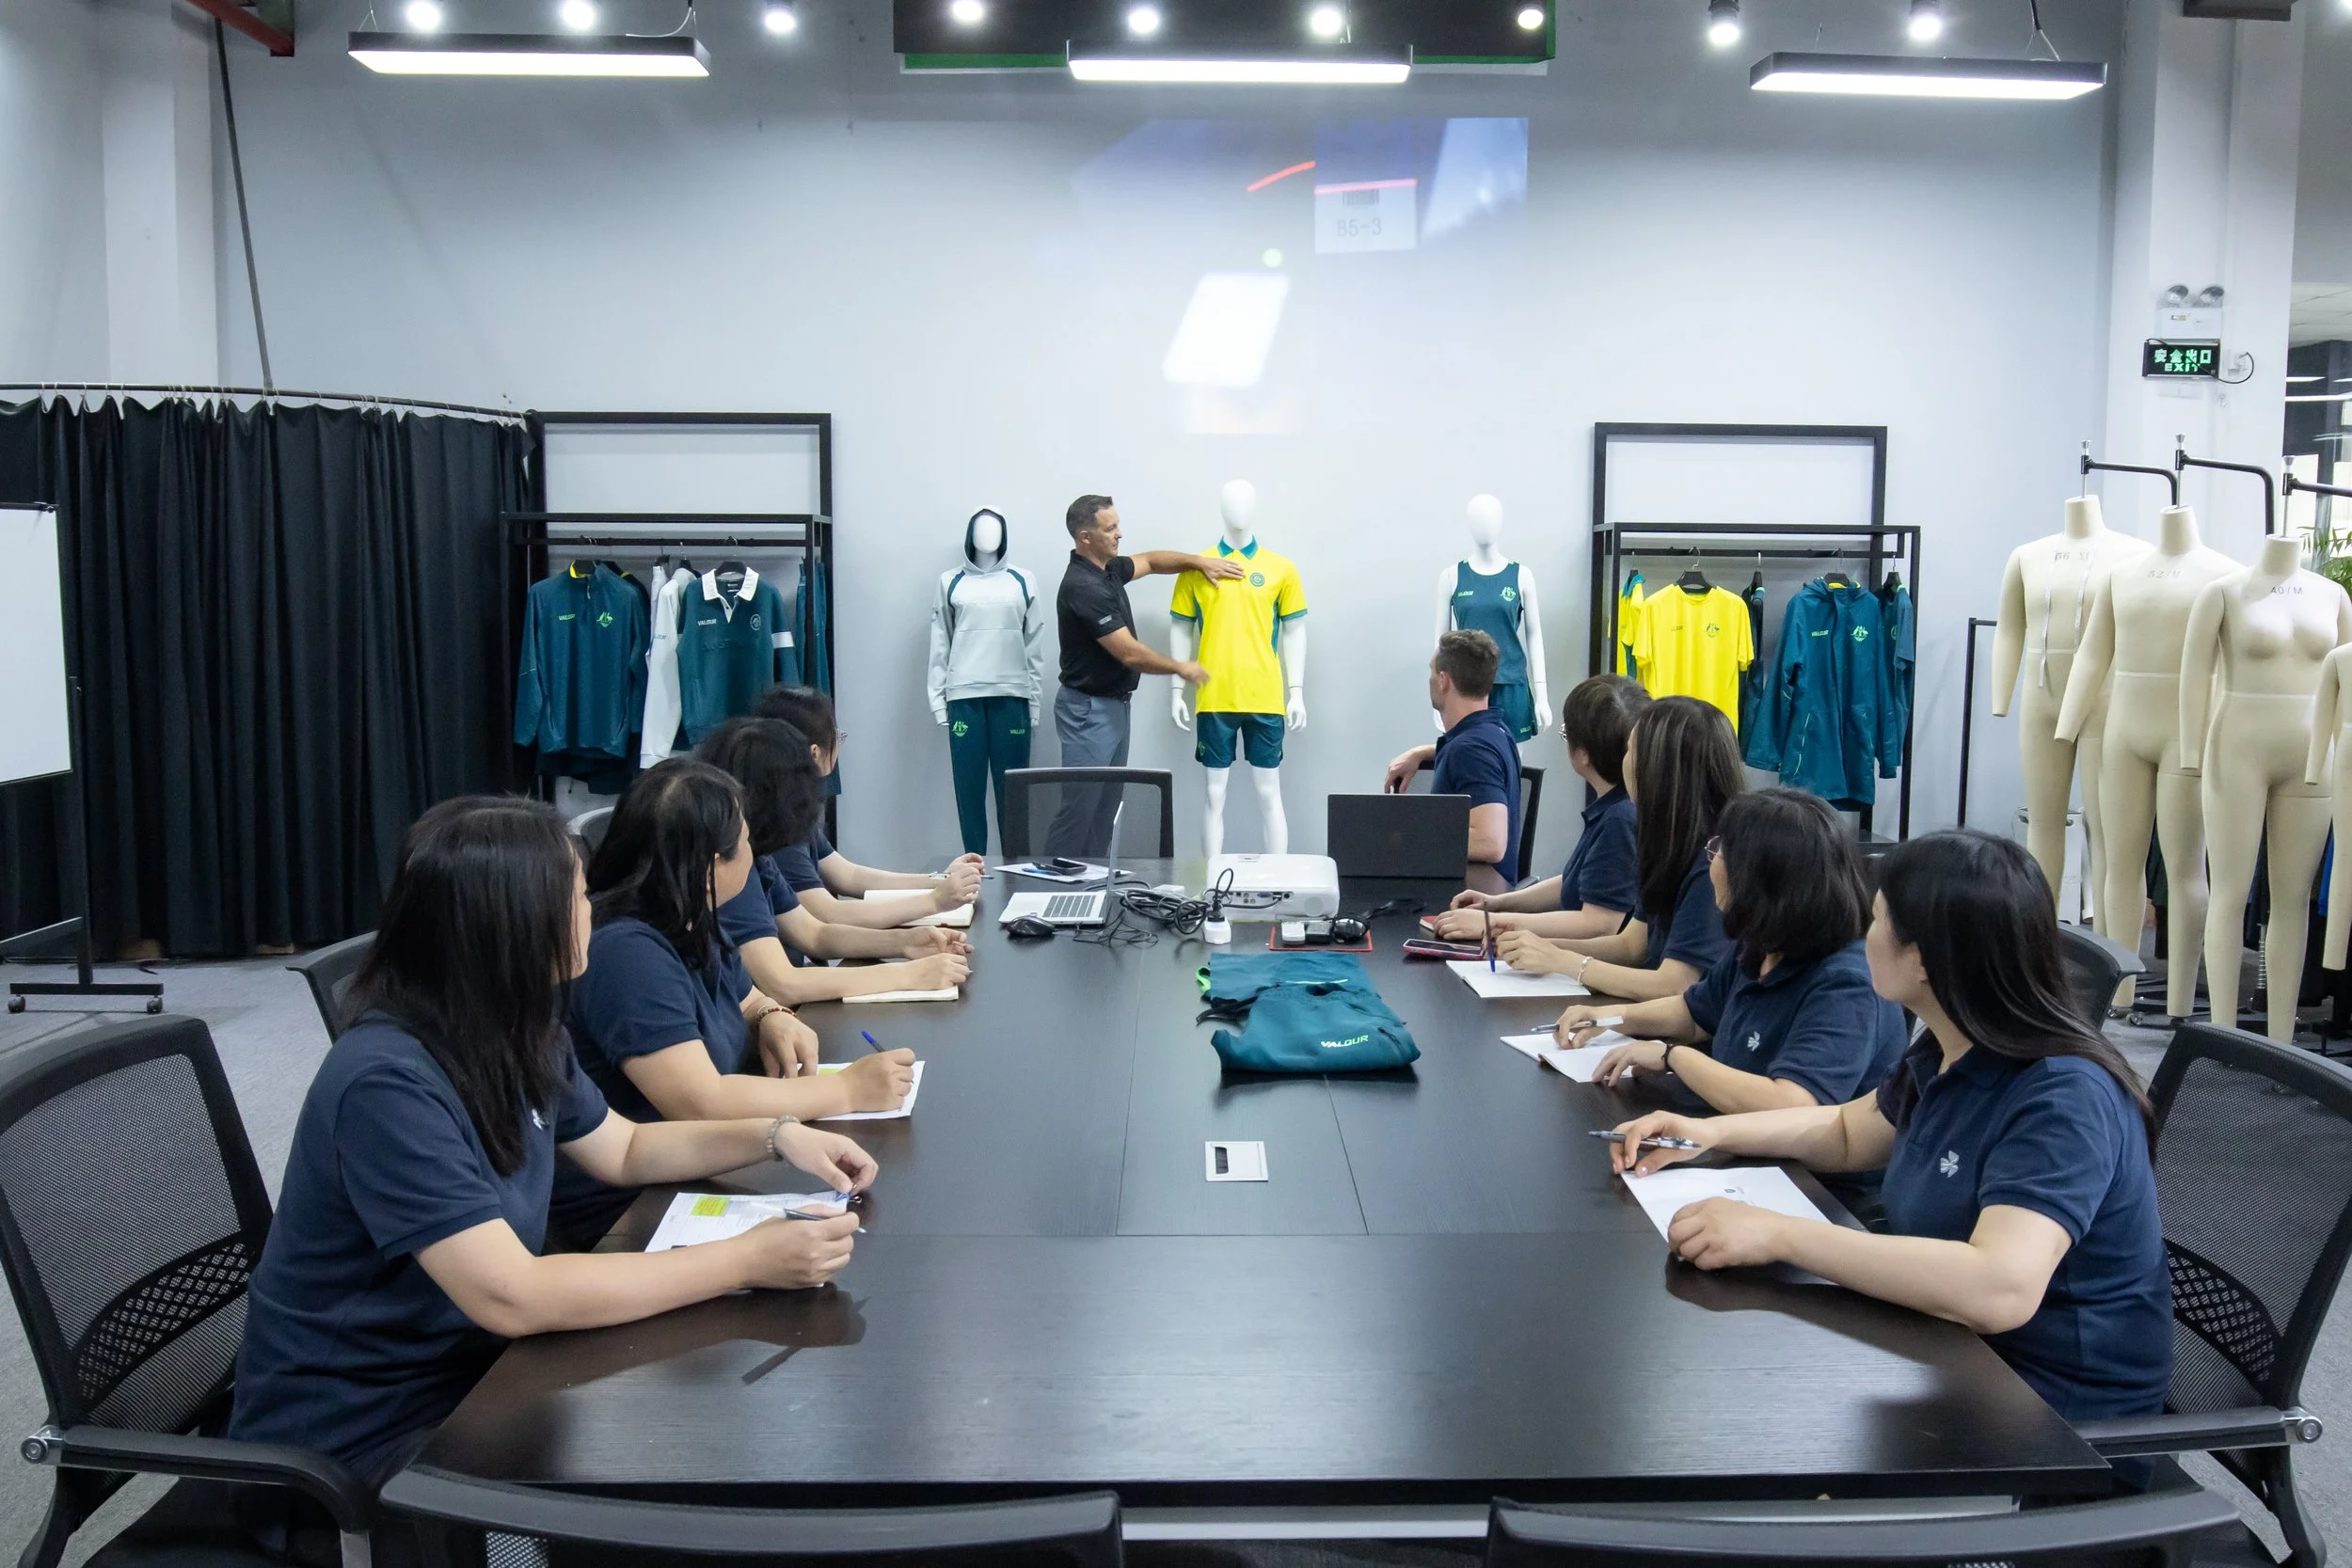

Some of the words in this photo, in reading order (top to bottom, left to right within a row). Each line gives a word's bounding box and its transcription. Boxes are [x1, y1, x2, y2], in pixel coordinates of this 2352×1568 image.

[1337, 217, 1382, 237] B5-3
[2154, 349, 2212, 364] 安全出口
[2164, 363, 2199, 372] EXIT
[697, 618, 717, 626] VALOUR
[1320, 1035, 1369, 1048] VALOUR
